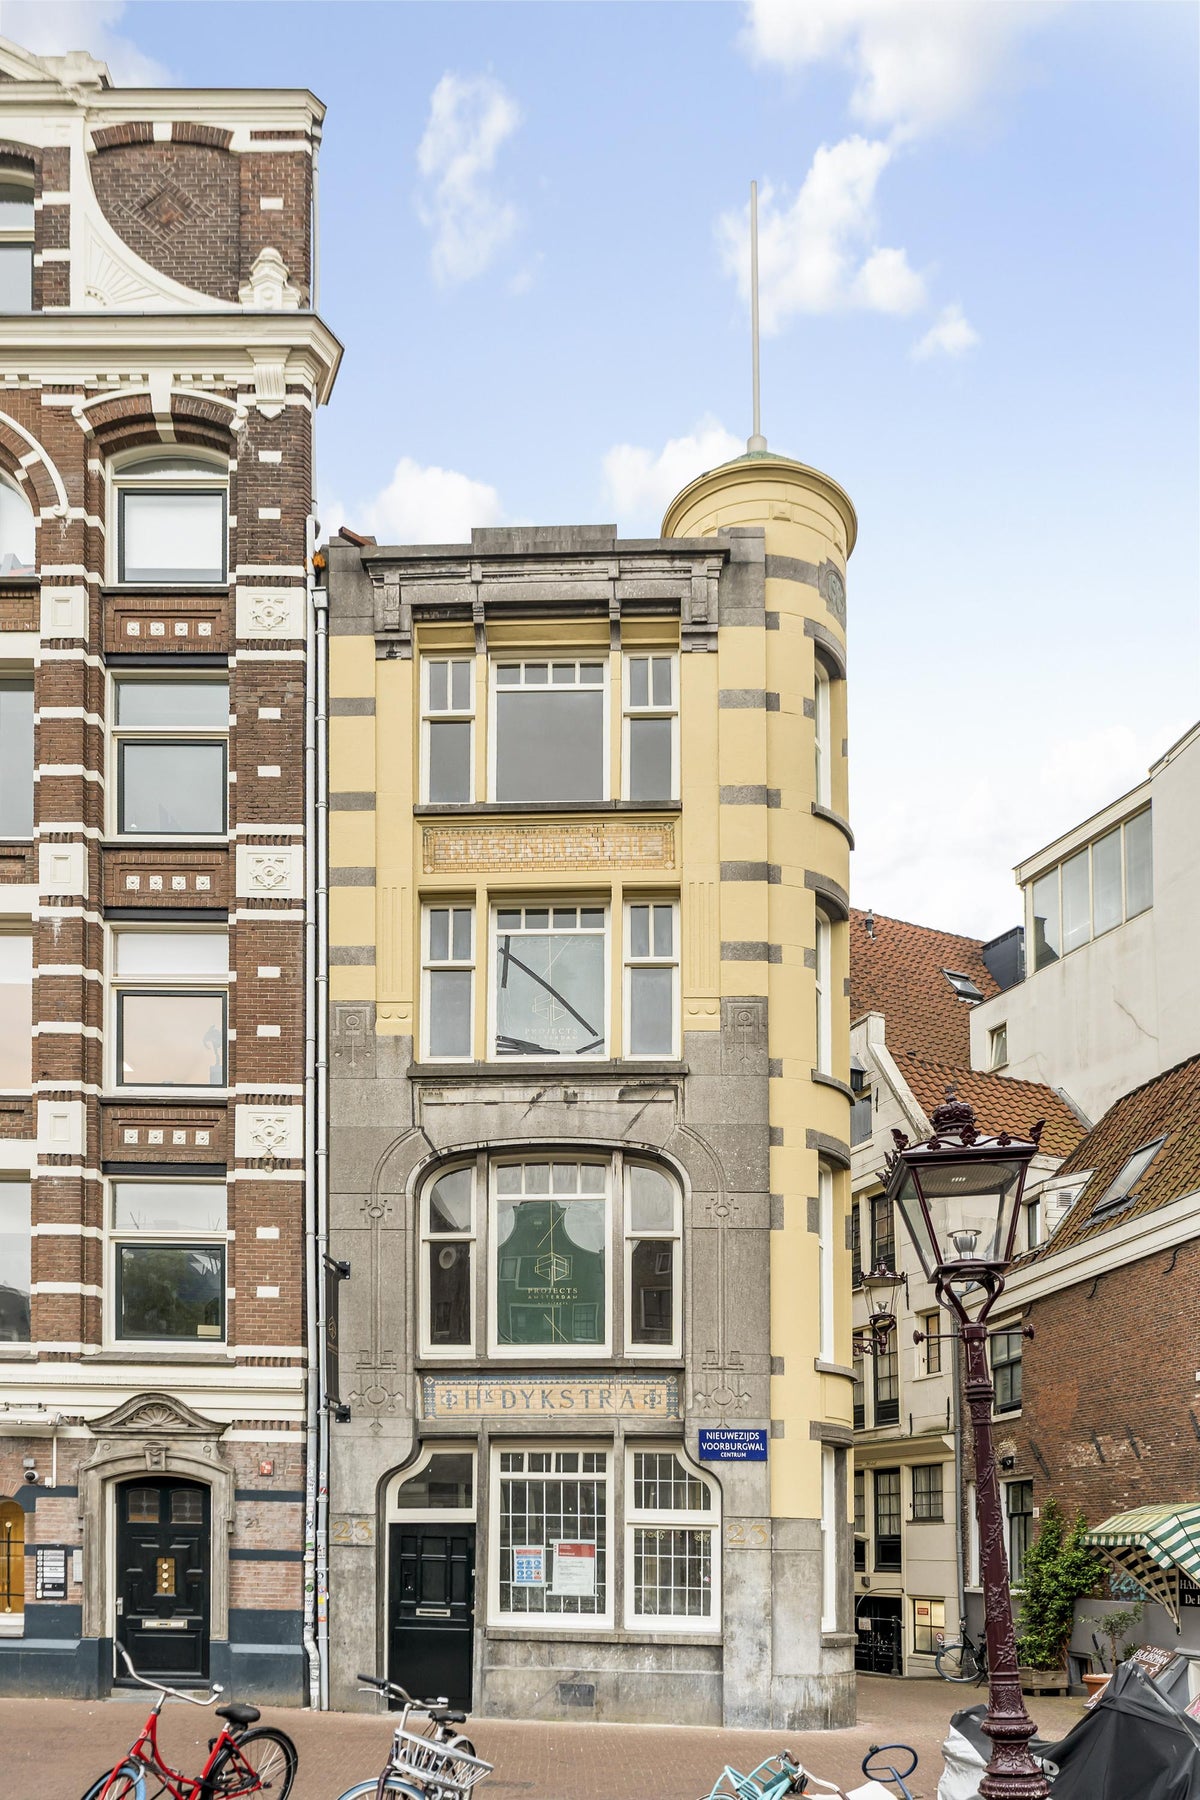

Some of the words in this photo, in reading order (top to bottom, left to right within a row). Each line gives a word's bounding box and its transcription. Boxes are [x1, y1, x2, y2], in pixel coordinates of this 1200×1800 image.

[501, 1388, 636, 1410] DYKSTRA
[701, 1442, 765, 1451] VOORBURGWAL
[706, 1431, 760, 1442] NIEUWEZIJDS
[332, 1520, 373, 1542] 23
[727, 1523, 769, 1545] 23
